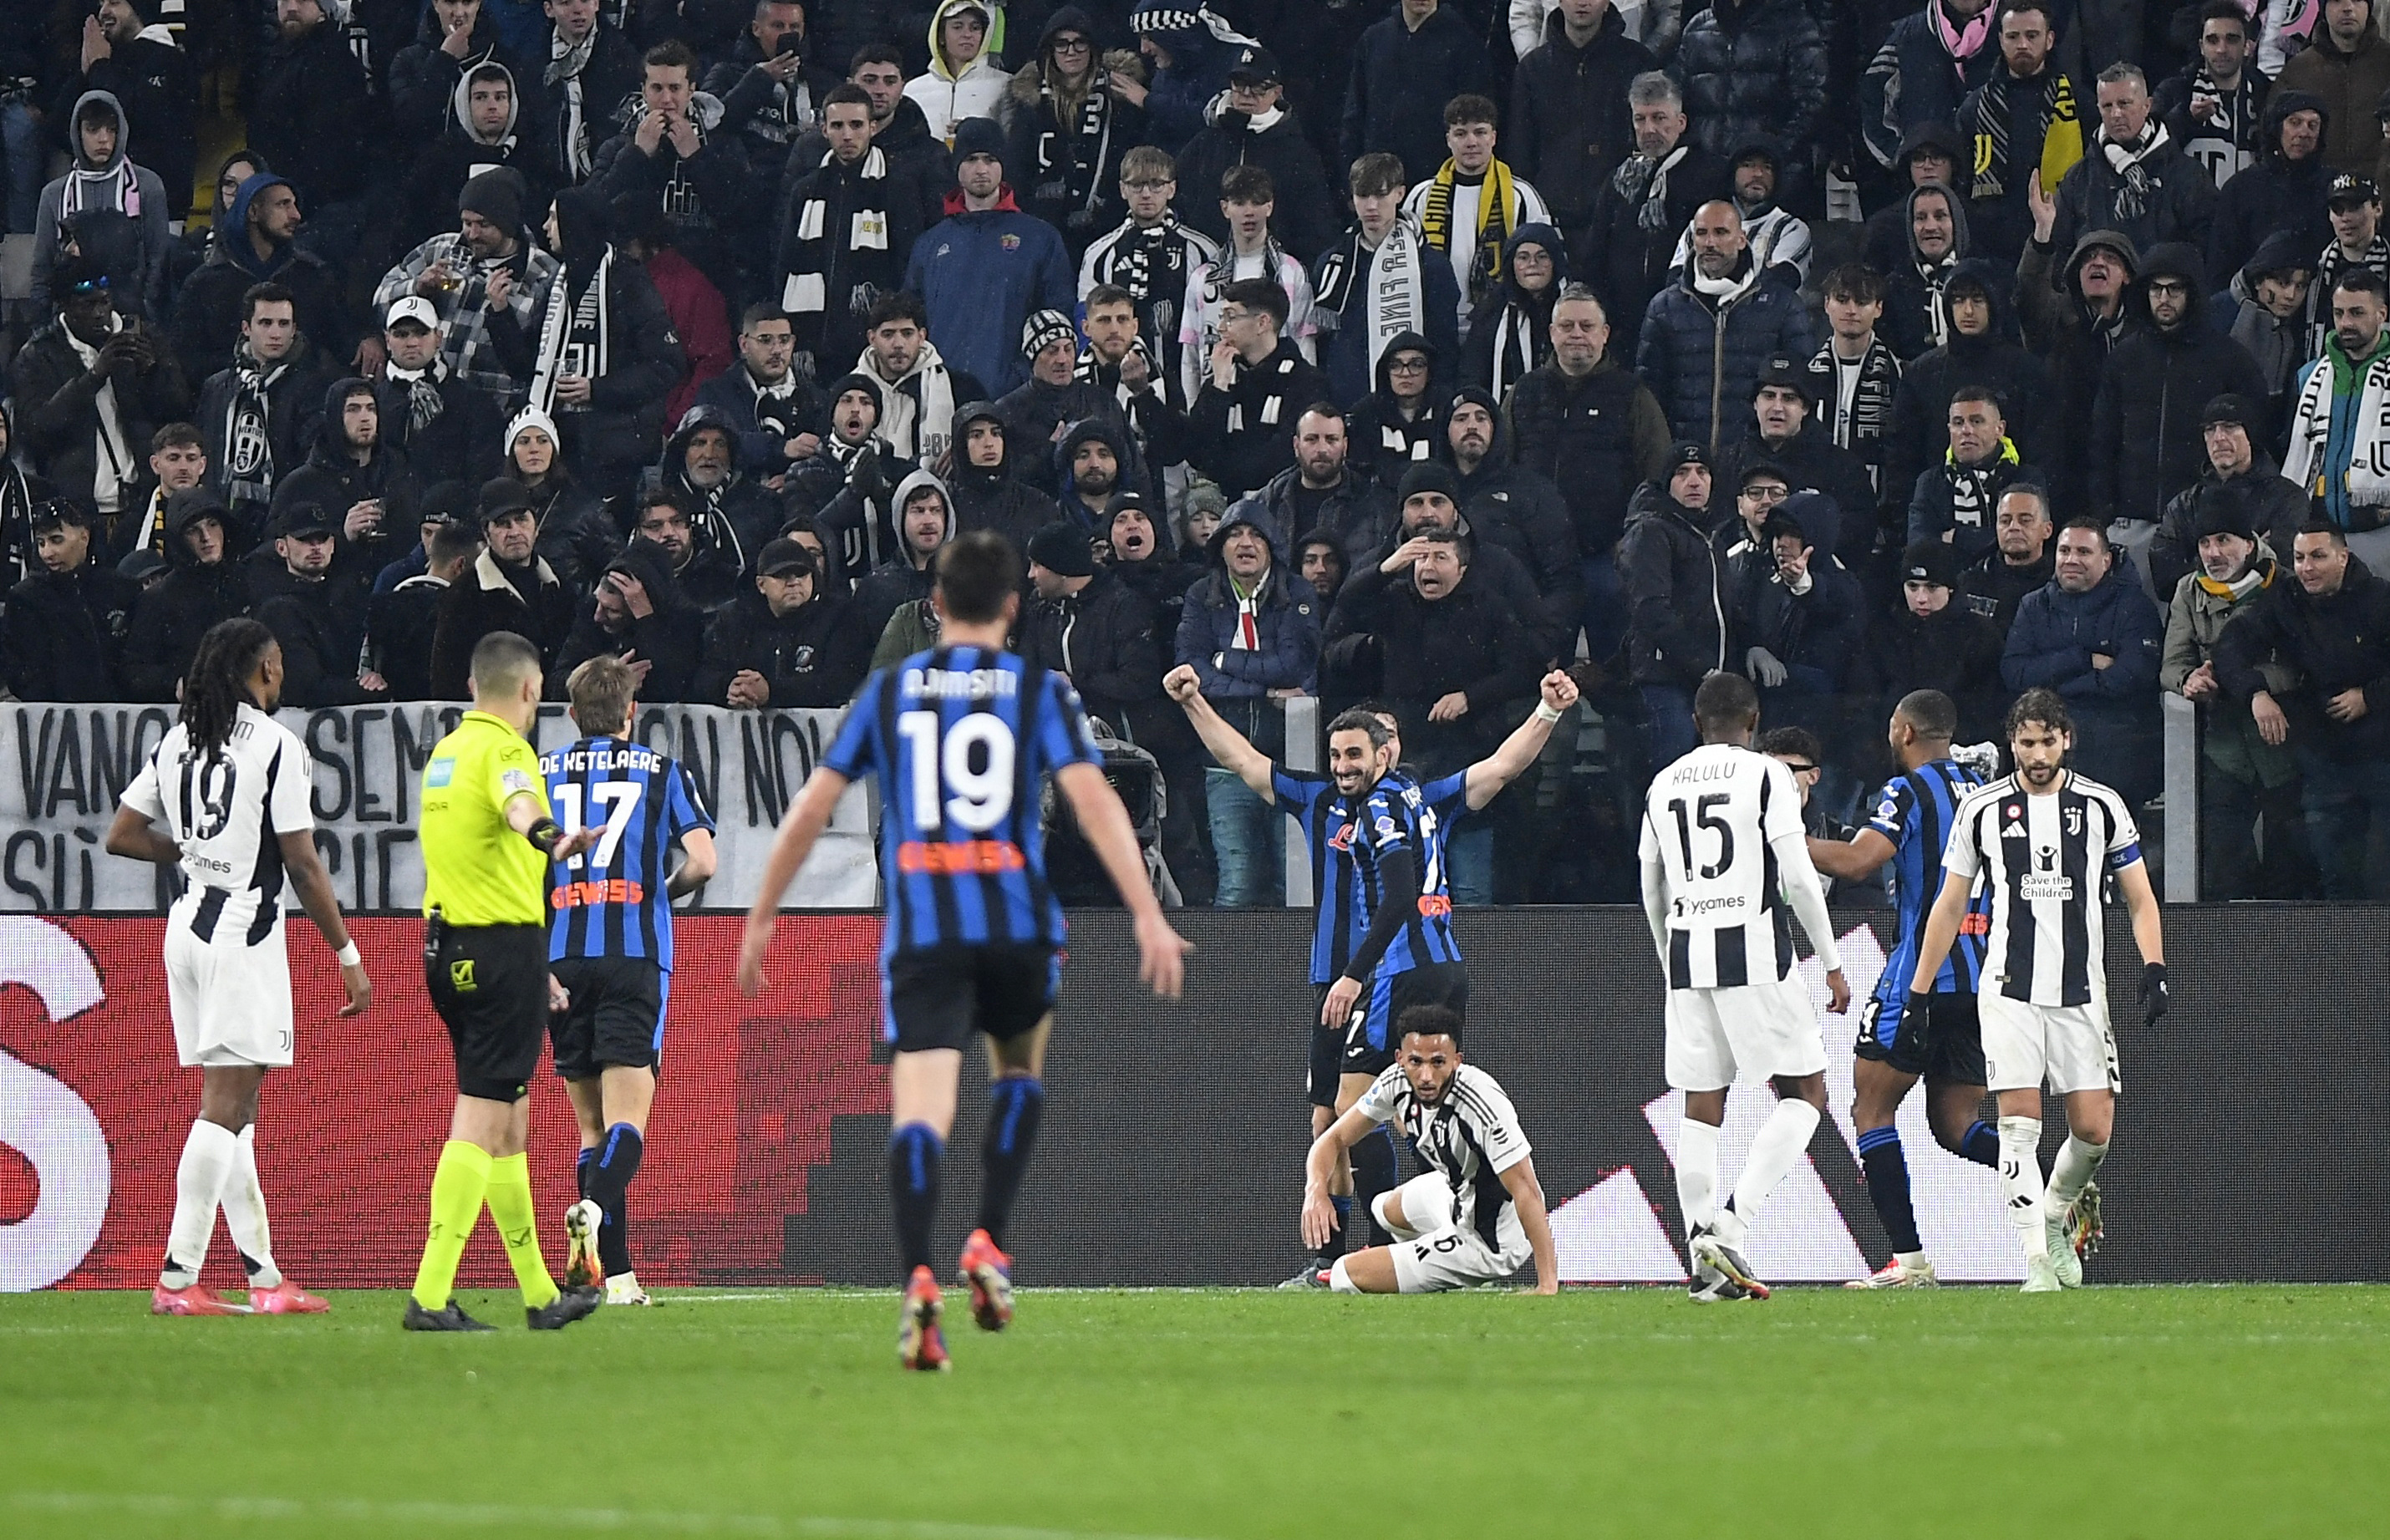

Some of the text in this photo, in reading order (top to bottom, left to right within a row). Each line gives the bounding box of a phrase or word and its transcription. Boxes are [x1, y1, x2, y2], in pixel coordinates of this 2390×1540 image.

[538, 750, 663, 775] DE KETELAERE
[898, 710, 1015, 831] 19
[1672, 762, 1737, 785] KALULU
[553, 780, 642, 870] 17
[1668, 792, 1734, 882] 15
[2022, 887, 2071, 898] Children
[2023, 875, 2070, 886] Save the
